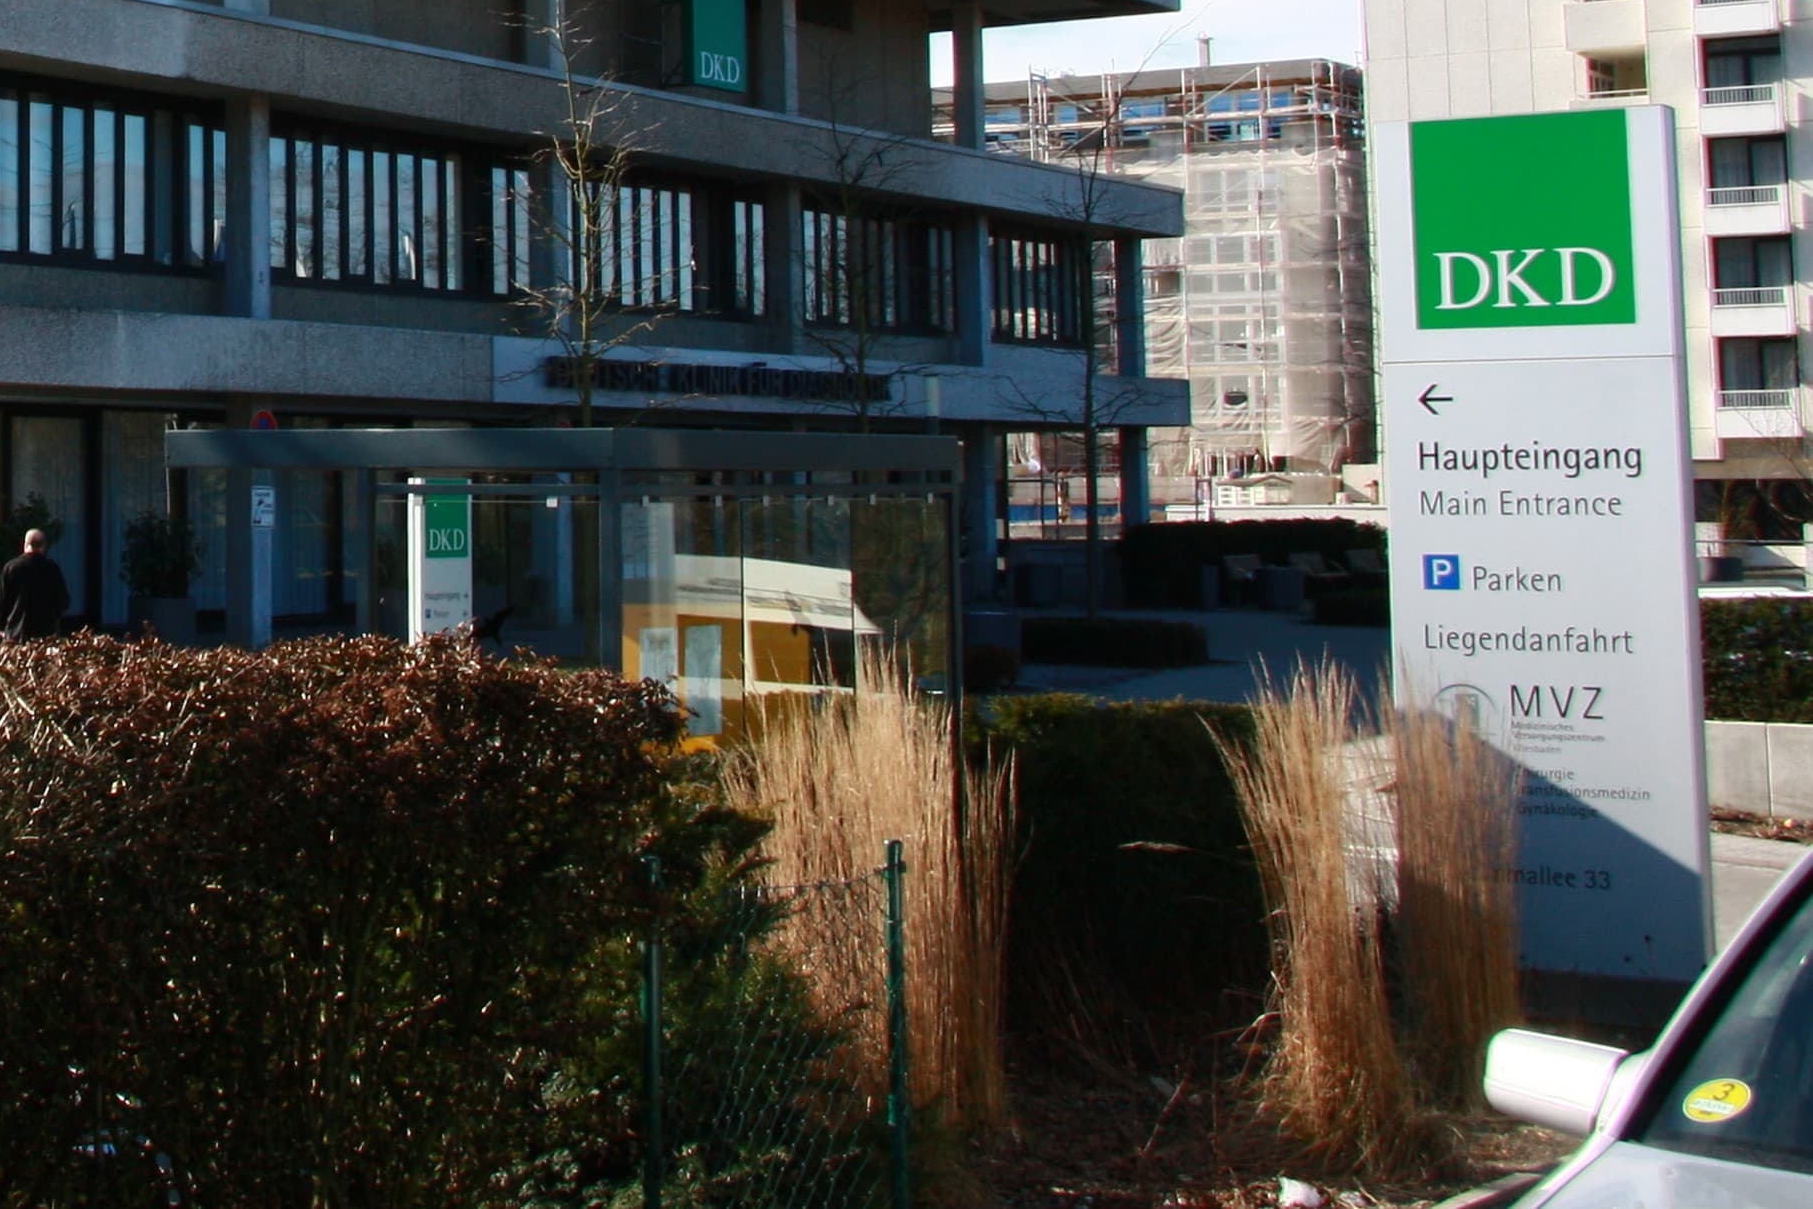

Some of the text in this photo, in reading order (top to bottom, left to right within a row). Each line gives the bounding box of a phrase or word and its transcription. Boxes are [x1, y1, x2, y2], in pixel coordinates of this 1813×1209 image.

[699, 51, 740, 84] DKD
[1432, 246, 1617, 310] DKD
[1418, 440, 1642, 478] Haupteingang
[1420, 490, 1622, 516] Main Entrance
[429, 528, 465, 551] DKD
[1432, 559, 1562, 592] P Parken
[1424, 624, 1634, 656] Liegendanfahrt
[1510, 684, 1604, 720] MVZ
[1519, 783, 1651, 801] ransfusionsmedizin
[1583, 868, 1611, 889] 33
